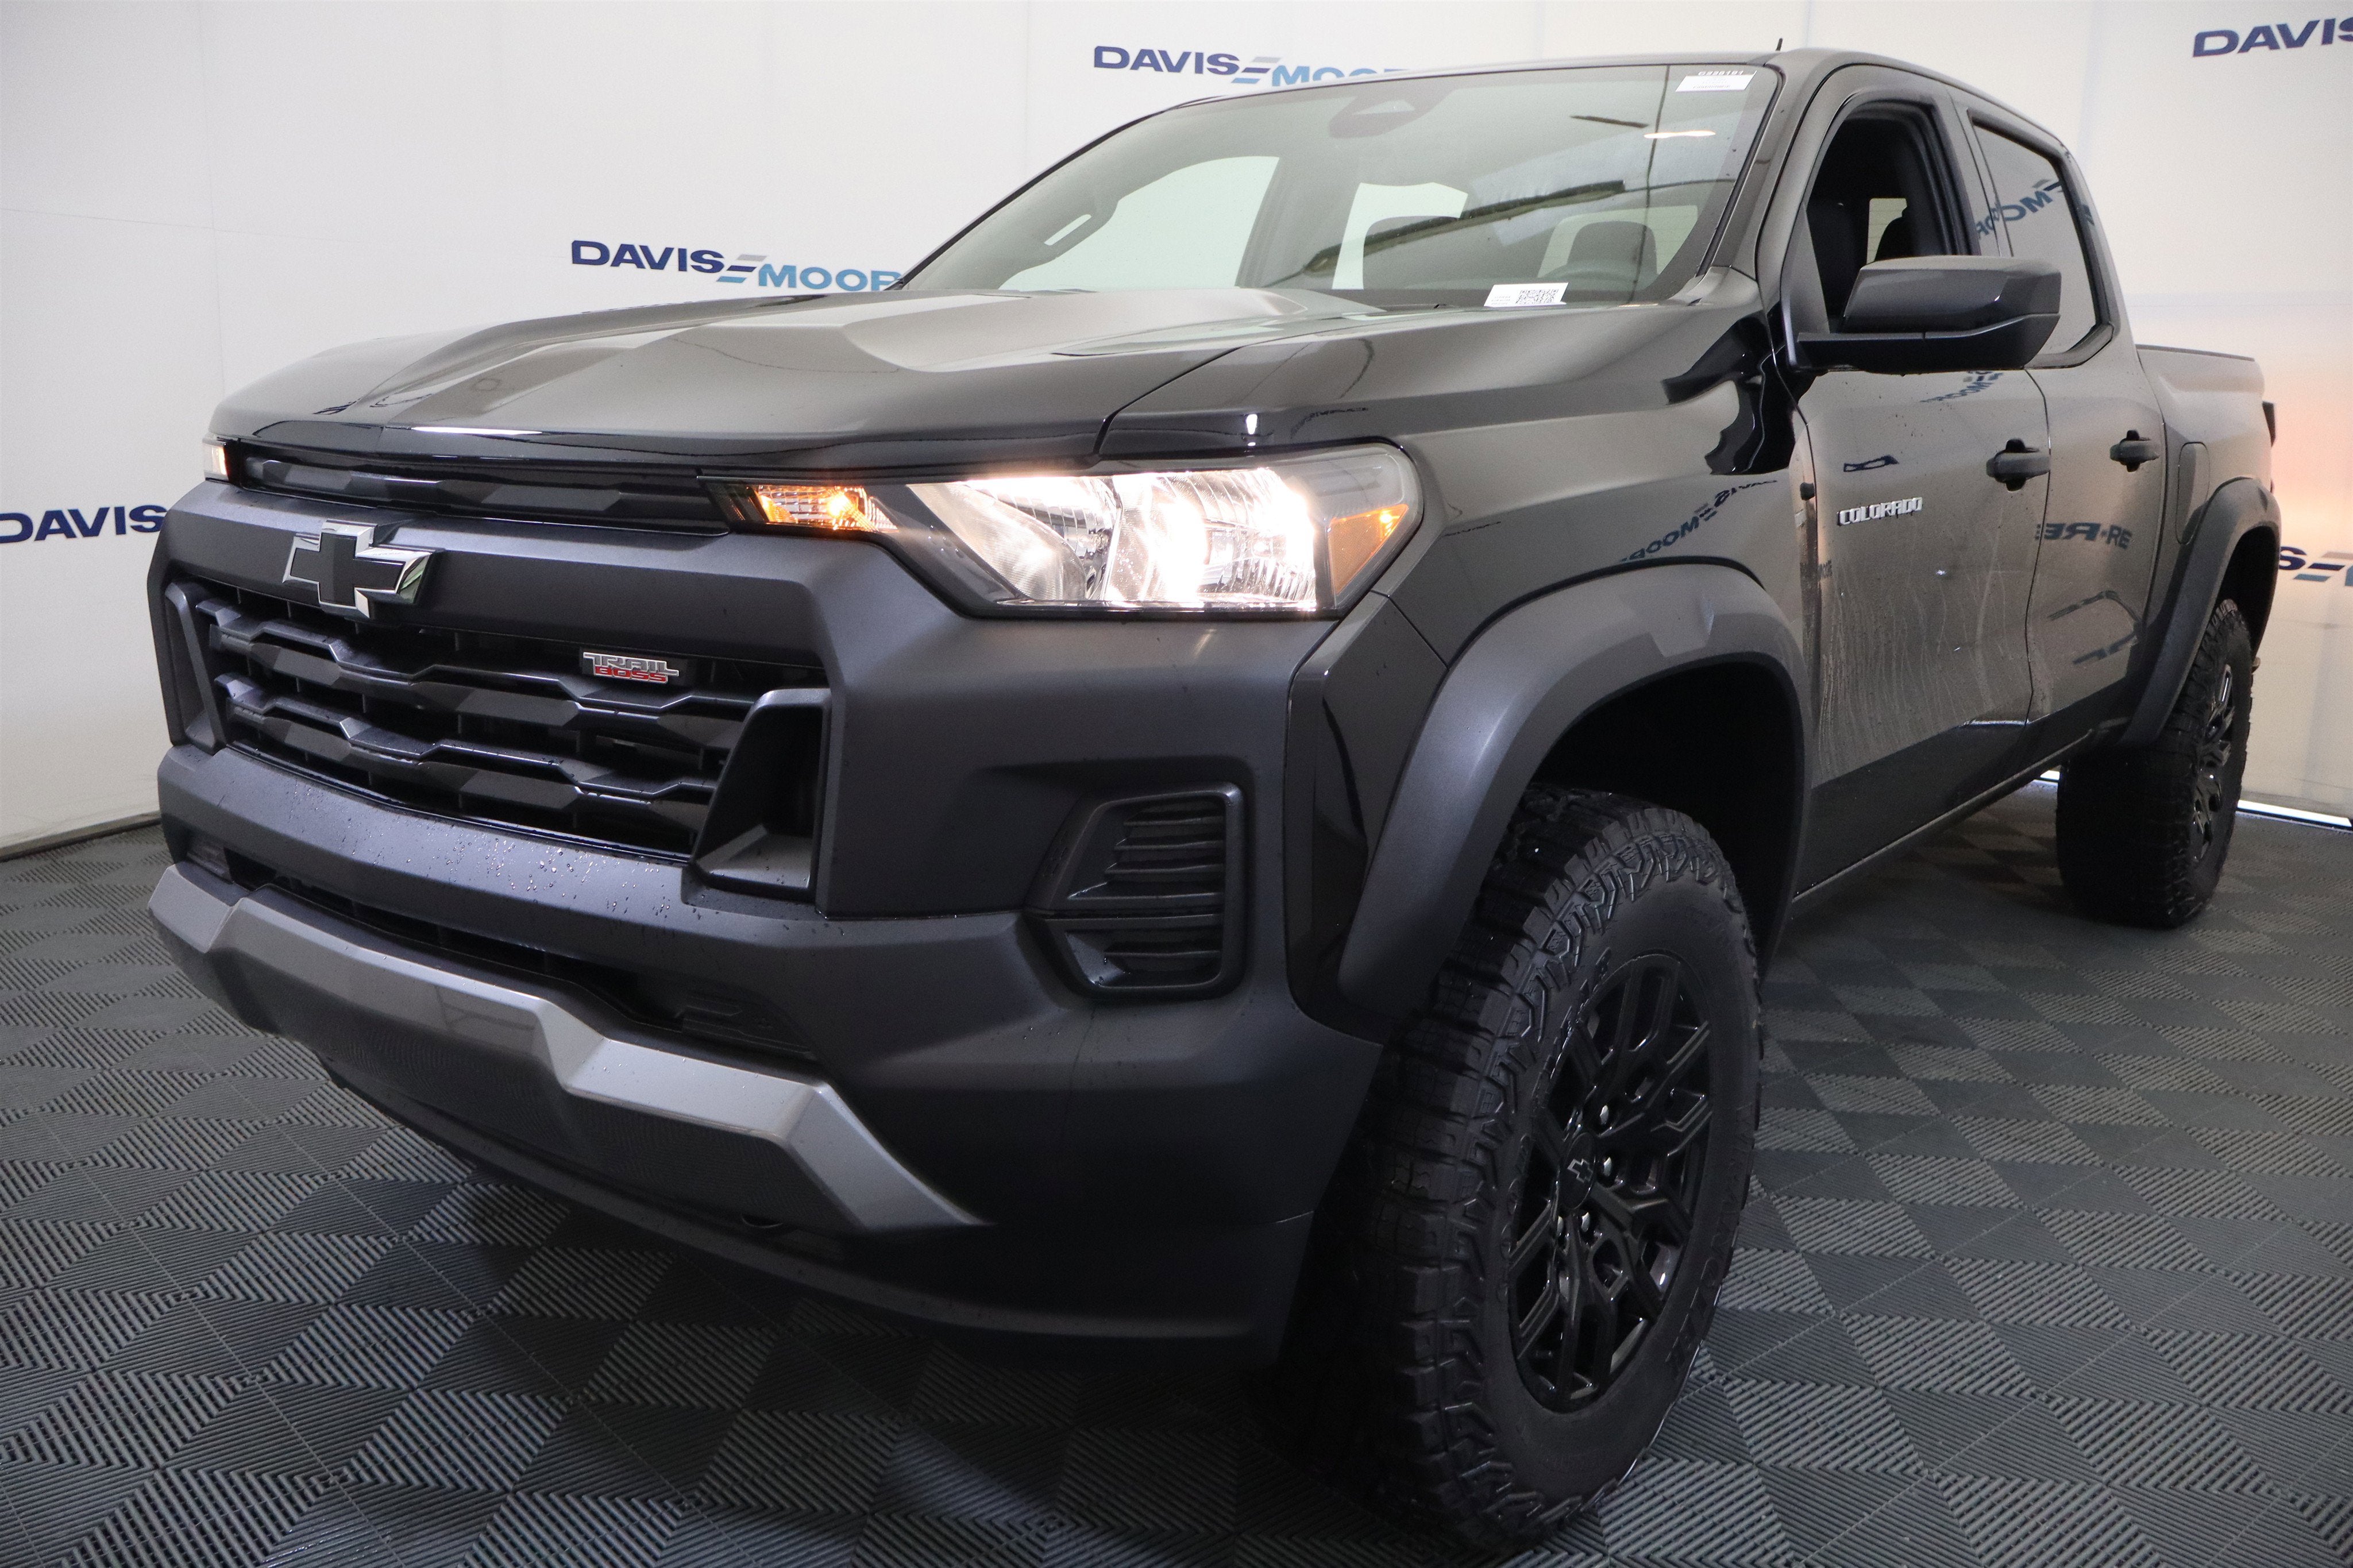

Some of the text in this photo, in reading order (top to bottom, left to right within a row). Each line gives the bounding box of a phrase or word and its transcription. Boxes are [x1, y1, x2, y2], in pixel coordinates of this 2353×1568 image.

[1094, 45, 1240, 75] DAVIS
[571, 240, 724, 273] DAVIS
[0, 505, 168, 543] DAVIS
[1839, 497, 1923, 525] COLORADO
[583, 652, 679, 676] TRAIL
[594, 665, 668, 684] BOSS
